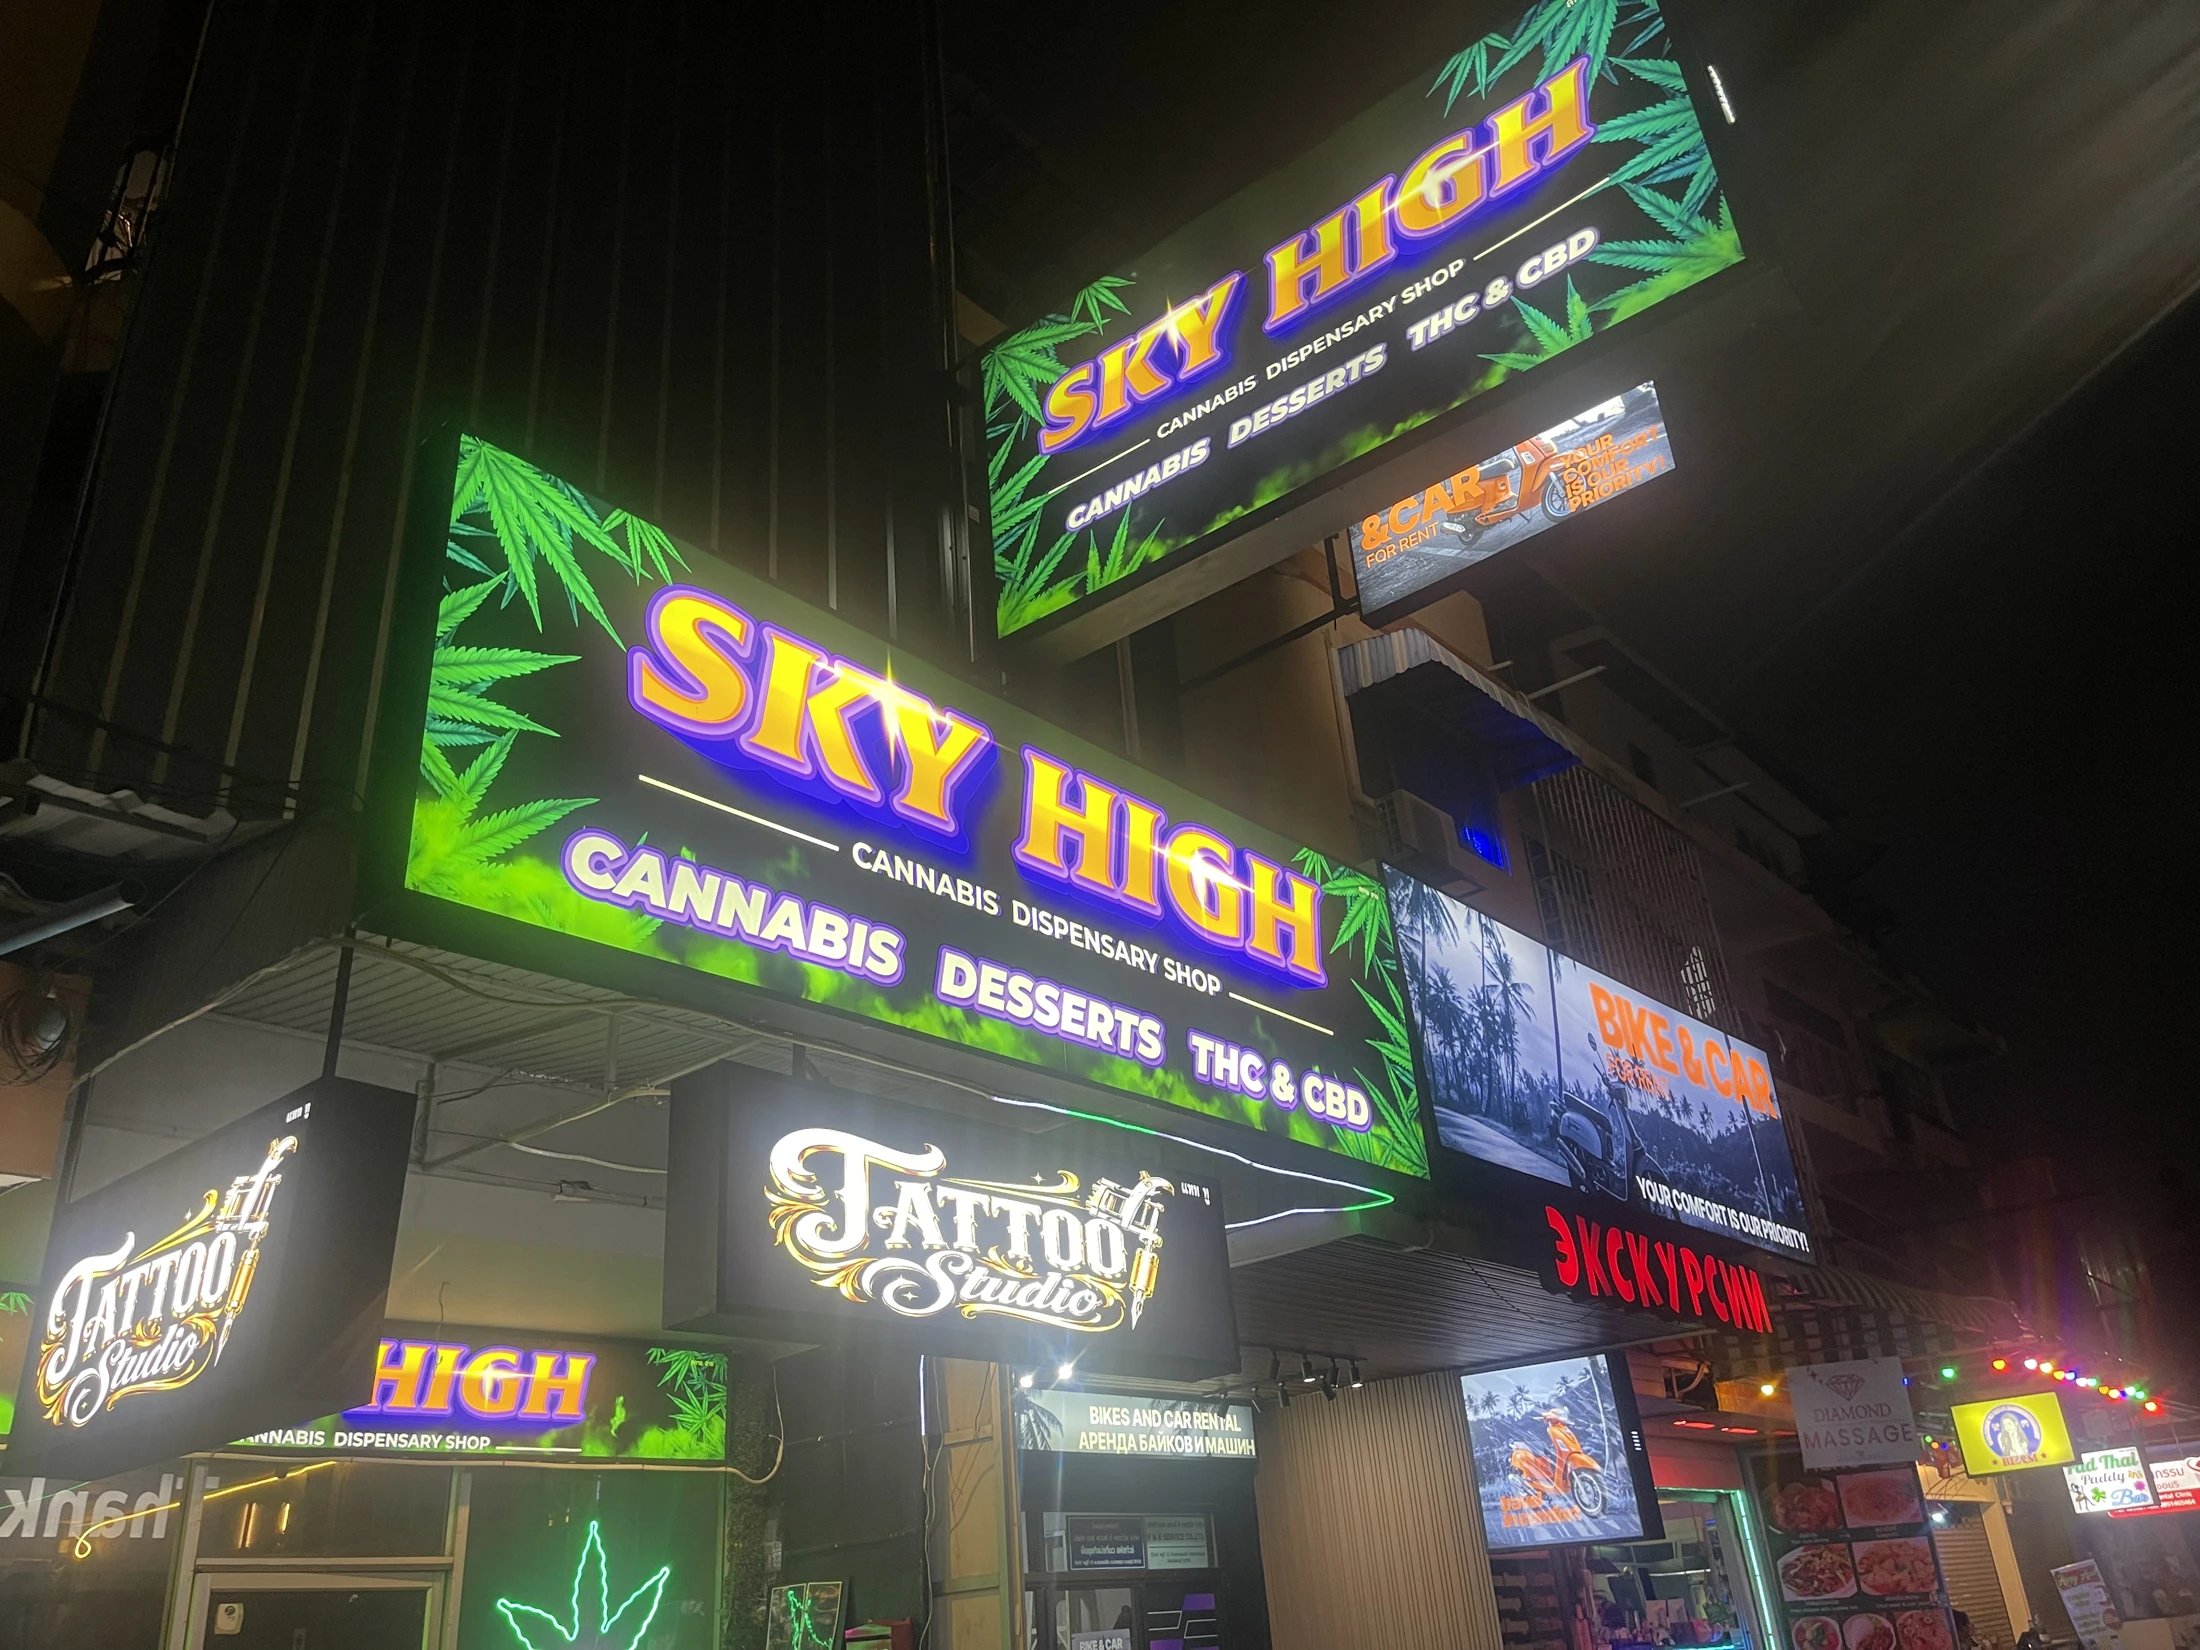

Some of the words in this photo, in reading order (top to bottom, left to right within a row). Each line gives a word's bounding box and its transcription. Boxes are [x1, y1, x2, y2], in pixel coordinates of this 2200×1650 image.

[1036, 271, 1244, 456] SKY
[1262, 53, 1597, 333] HIGH
[1156, 374, 1257, 438] CANNABIS
[1264, 297, 1399, 381] DISPENSARY
[1400, 258, 1465, 306] SHOP
[1066, 438, 1210, 531] CANNABIS
[1228, 343, 1387, 450] DESSERTS
[1407, 294, 1479, 351] THC
[1483, 272, 1512, 308] &
[1516, 226, 1599, 287] CBD
[1560, 433, 1614, 469] YOUR
[1563, 425, 1659, 483] COMFORT
[1565, 479, 1584, 498] IS
[1587, 458, 1629, 487] OUR
[1568, 454, 1666, 512] PRIORITY!
[1365, 544, 1397, 568] FOR
[1399, 521, 1439, 553] RENT
[627, 583, 995, 836] SKY
[1012, 743, 1329, 991] HIGH
[851, 841, 1001, 918] CANNABIS
[1011, 899, 1159, 976] DISPENSARY
[1163, 957, 1223, 997] SHOP
[561, 827, 906, 987] CANNABIS
[935, 944, 1167, 1068] DESSERTS
[1187, 1028, 1267, 1103] THC
[1269, 1062, 1299, 1109] &
[1301, 1074, 1374, 1133] CBD
[1587, 981, 1681, 1078] BIKE
[1676, 1024, 1709, 1092] &
[1704, 1038, 1778, 1121] CAR
[1635, 1175, 1673, 1208] YOUR
[1672, 1190, 1728, 1224] COMFORT
[1728, 1208, 1741, 1231] IS
[1739, 1211, 1762, 1238] OUR
[1760, 1218, 1810, 1253] PRIORITY!
[861, 1250, 1104, 1318] Studio
[1544, 1204, 1774, 1334] ЭКСКУРСИИ
[64, 1322, 200, 1427] Studio
[369, 1338, 597, 1422] HIGH
[333, 1430, 442, 1450] DISPENSARY
[444, 1433, 491, 1451] SHOP
[1078, 1432, 1138, 1454] АРЕНДА
[1139, 1430, 1193, 1453] БАЙКОВ
[1194, 1438, 1204, 1453] И
[1089, 1406, 1130, 1426] BIKES
[1132, 1409, 1162, 1428] AND
[1163, 1410, 1192, 1429] CAR
[1803, 1423, 1913, 1449] MASSAGE
[1813, 1403, 1892, 1423] DIAMOND
[2081, 1471, 2125, 1485] Paddy
[2099, 1451, 2139, 1470] Thai
[2111, 1488, 2149, 1506] Bar
